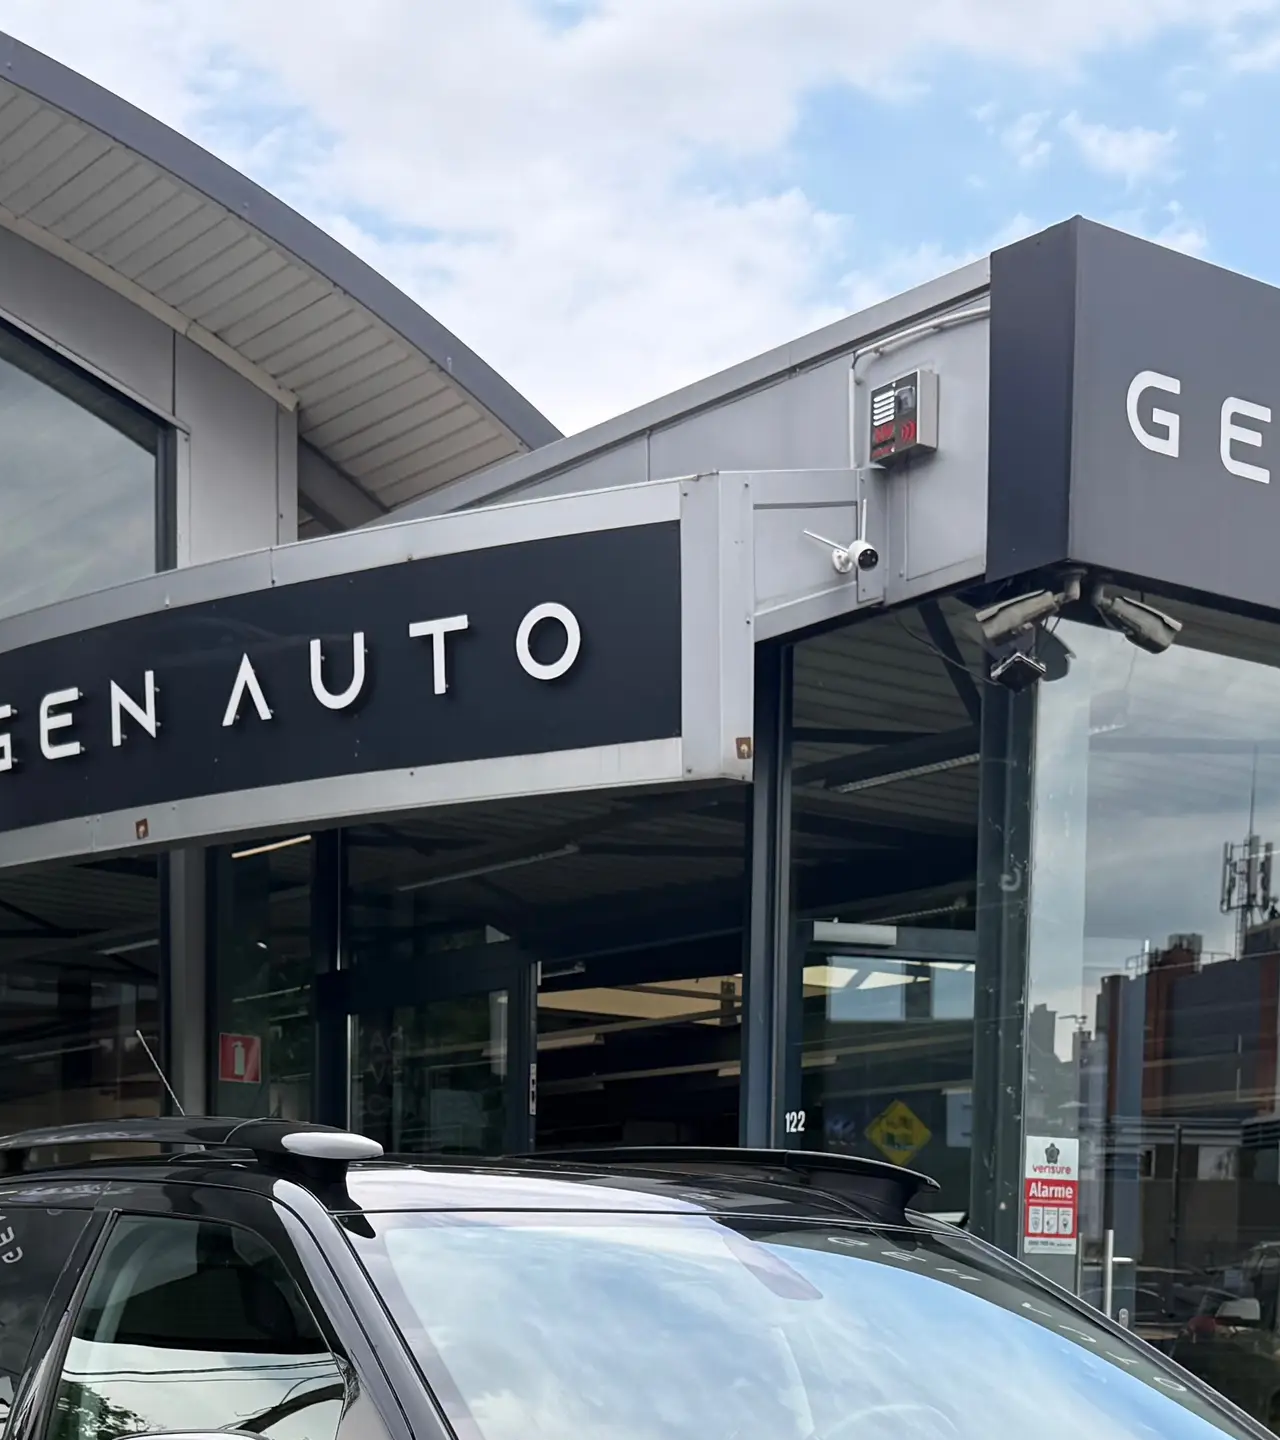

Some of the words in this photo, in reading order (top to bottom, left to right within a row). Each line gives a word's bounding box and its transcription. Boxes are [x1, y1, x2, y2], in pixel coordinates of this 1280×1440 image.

[221, 601, 584, 728] AUTO
[785, 1110, 806, 1133] 122
[1028, 1181, 1074, 1199] Alarme
